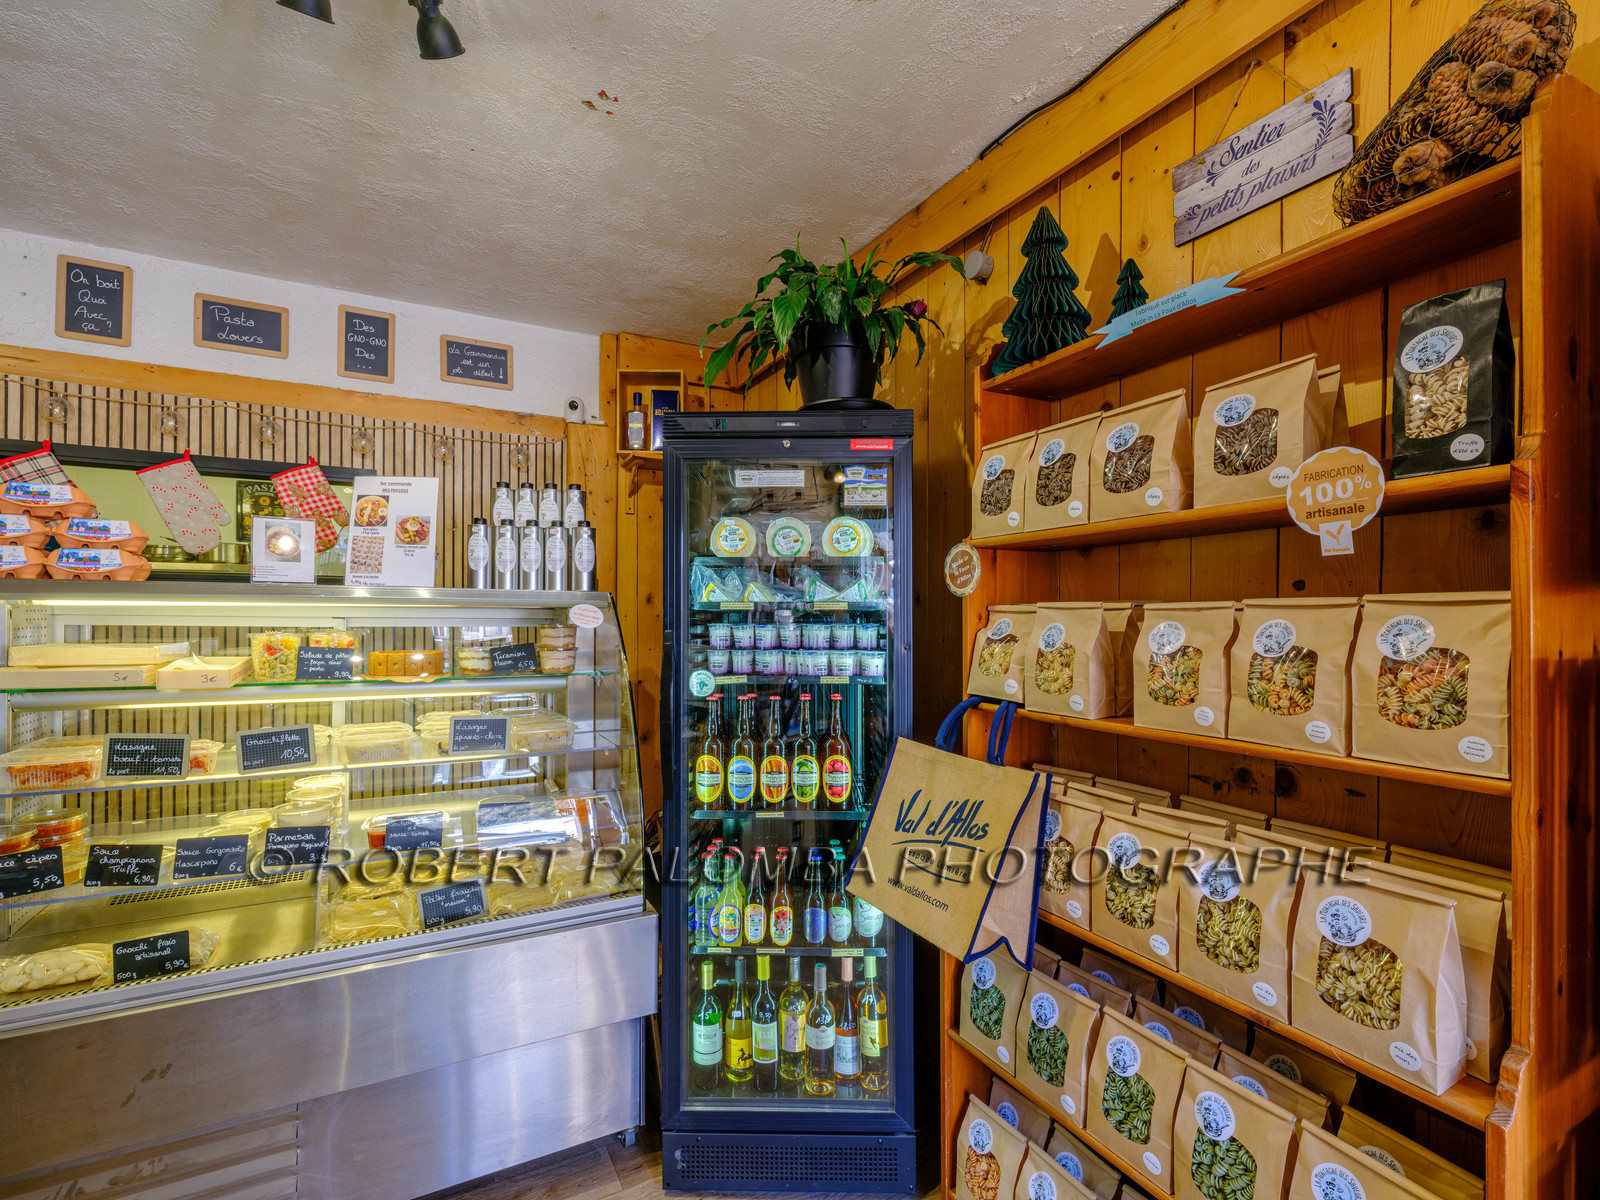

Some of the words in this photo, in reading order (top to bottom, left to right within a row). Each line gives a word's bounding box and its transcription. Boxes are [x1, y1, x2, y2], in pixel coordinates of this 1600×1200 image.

[1220, 121, 1286, 168] Sentier
[1241, 159, 1260, 178] des
[1189, 183, 1245, 235] petits
[1237, 151, 1318, 212] plaisirs
[70, 268, 90, 285] On
[95, 273, 120, 289] boit
[1134, 302, 1160, 317] Fabriqué
[1160, 296, 1171, 307] sur
[1171, 290, 1188, 304] place
[74, 305, 108, 320] Avec
[209, 305, 255, 327] Pasta
[1130, 316, 1147, 328] Made
[1147, 313, 1154, 322] in
[1154, 311, 1161, 319] La
[1161, 305, 1176, 316] Foux
[1176, 297, 1197, 311] d'Allos
[82, 322, 100, 331] ça
[106, 321, 112, 332] ?
[353, 319, 375, 333] Des
[217, 326, 263, 344] Lovers
[347, 333, 387, 347] GNO-GNO
[354, 347, 375, 359] Des
[448, 344, 461, 354] La
[460, 358, 474, 366] est
[450, 366, 463, 375] joli
[473, 369, 494, 378] défaut
[1304, 464, 1364, 483] FABRICATION
[1299, 473, 1372, 506] 100%
[1305, 503, 1365, 520] artisanale
[951, 558, 964, 568] Made
[894, 789, 932, 833] Val
[925, 798, 990, 847] d'Allos
[268, 832, 316, 842] Parmesan
[93, 846, 119, 856] Sauce
[176, 848, 201, 856] Sauce
[908, 848, 935, 865] espace
[25, 854, 58, 864] cèpes
[99, 855, 156, 866] champignons
[109, 863, 141, 874] Truffe
[887, 876, 949, 912] www.valdallos.com
[1341, 899, 1352, 907] DES
[116, 942, 149, 955] Gnocchi
[1339, 1170, 1350, 1181] DES
